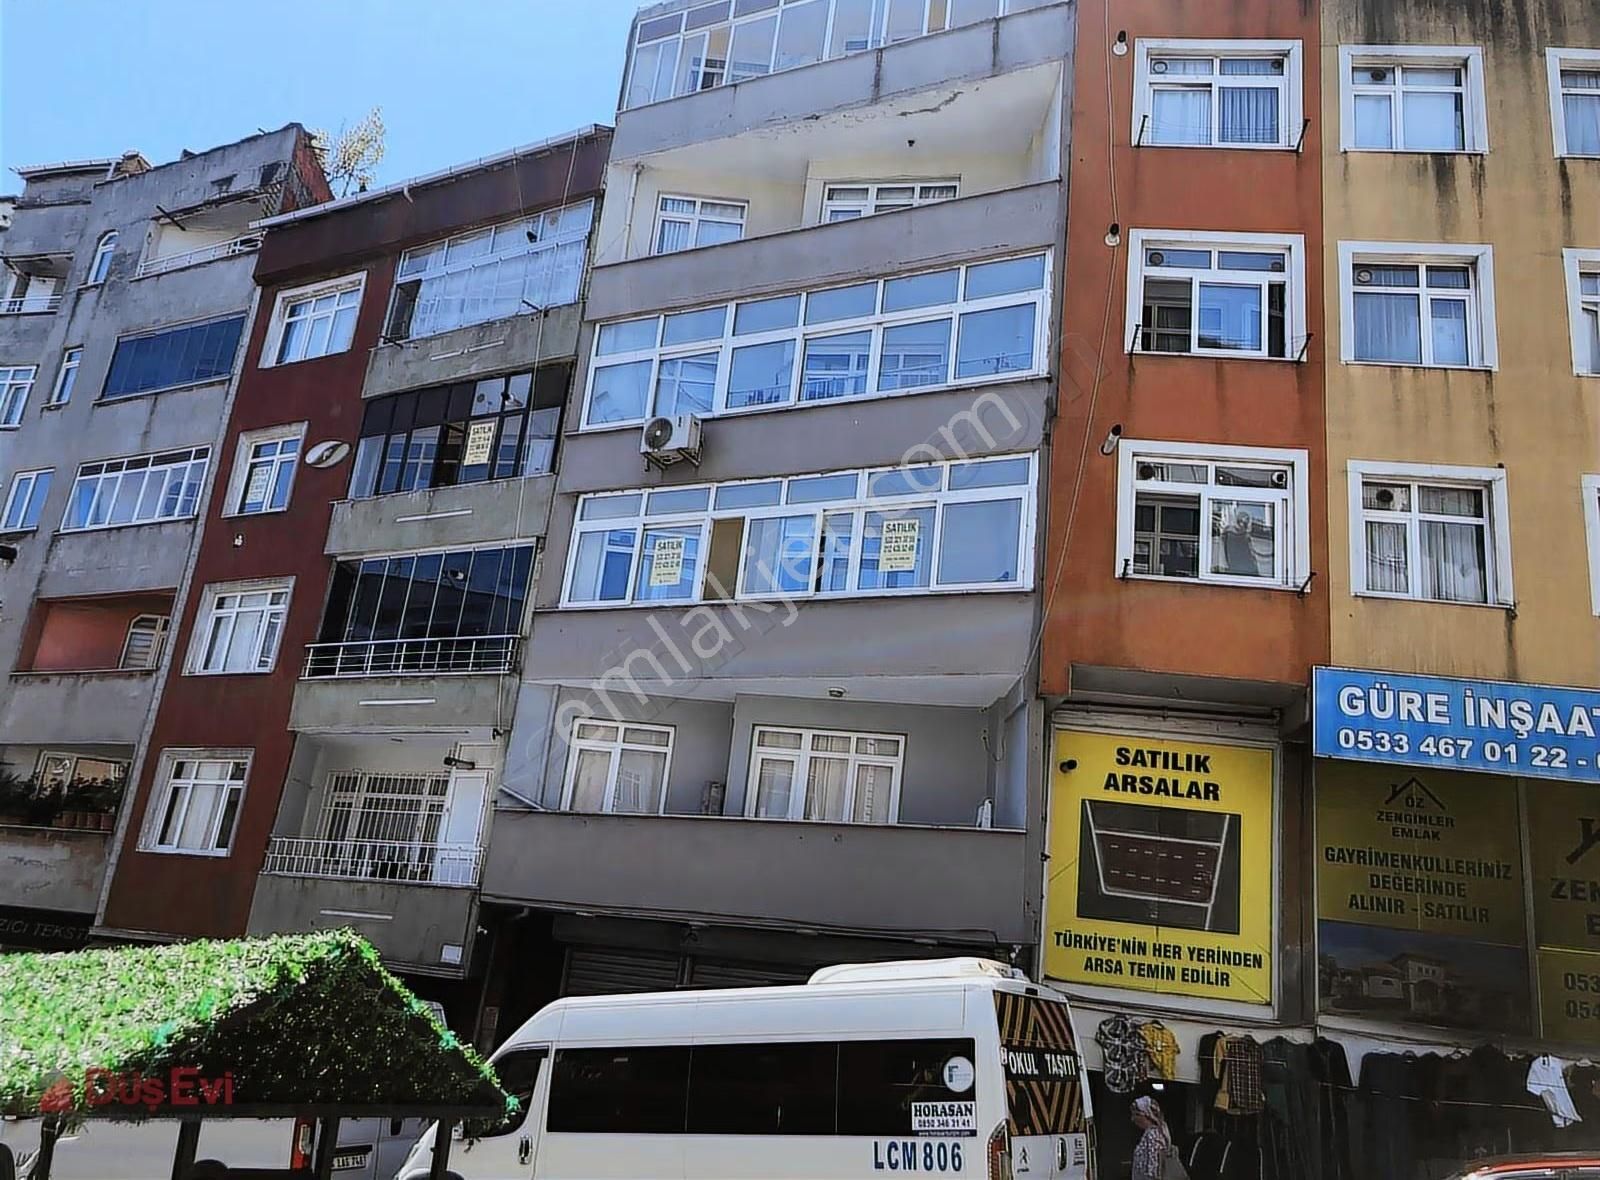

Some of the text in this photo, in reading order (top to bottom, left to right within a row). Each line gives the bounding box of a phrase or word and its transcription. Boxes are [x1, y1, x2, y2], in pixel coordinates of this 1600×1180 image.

[885, 522, 917, 534] SATILIK
[1339, 682, 1600, 739] GÜRE İNŞAA
[1115, 747, 1211, 774] SATILIK
[1339, 728, 1409, 754] 0533
[1419, 736, 1473, 759] 467
[1484, 742, 1518, 764] 01
[1531, 746, 1568, 769] 22
[1104, 772, 1220, 801] ARSALAR
[1392, 826, 1441, 841] EMLAK
[1370, 871, 1467, 898] DEĞERİNDE
[1348, 894, 1405, 915] ALINIR
[1424, 901, 1489, 923] SATILIR
[1054, 929, 1263, 969] TÜRKİYE'NİN HER YERİNDEN
[1083, 956, 1231, 987] ARSA TEMİN EDİLİR
[1009, 1053, 1039, 1076] OKUL
[914, 1104, 974, 1119] HORASAN
[874, 1141, 962, 1172] LCM 806
